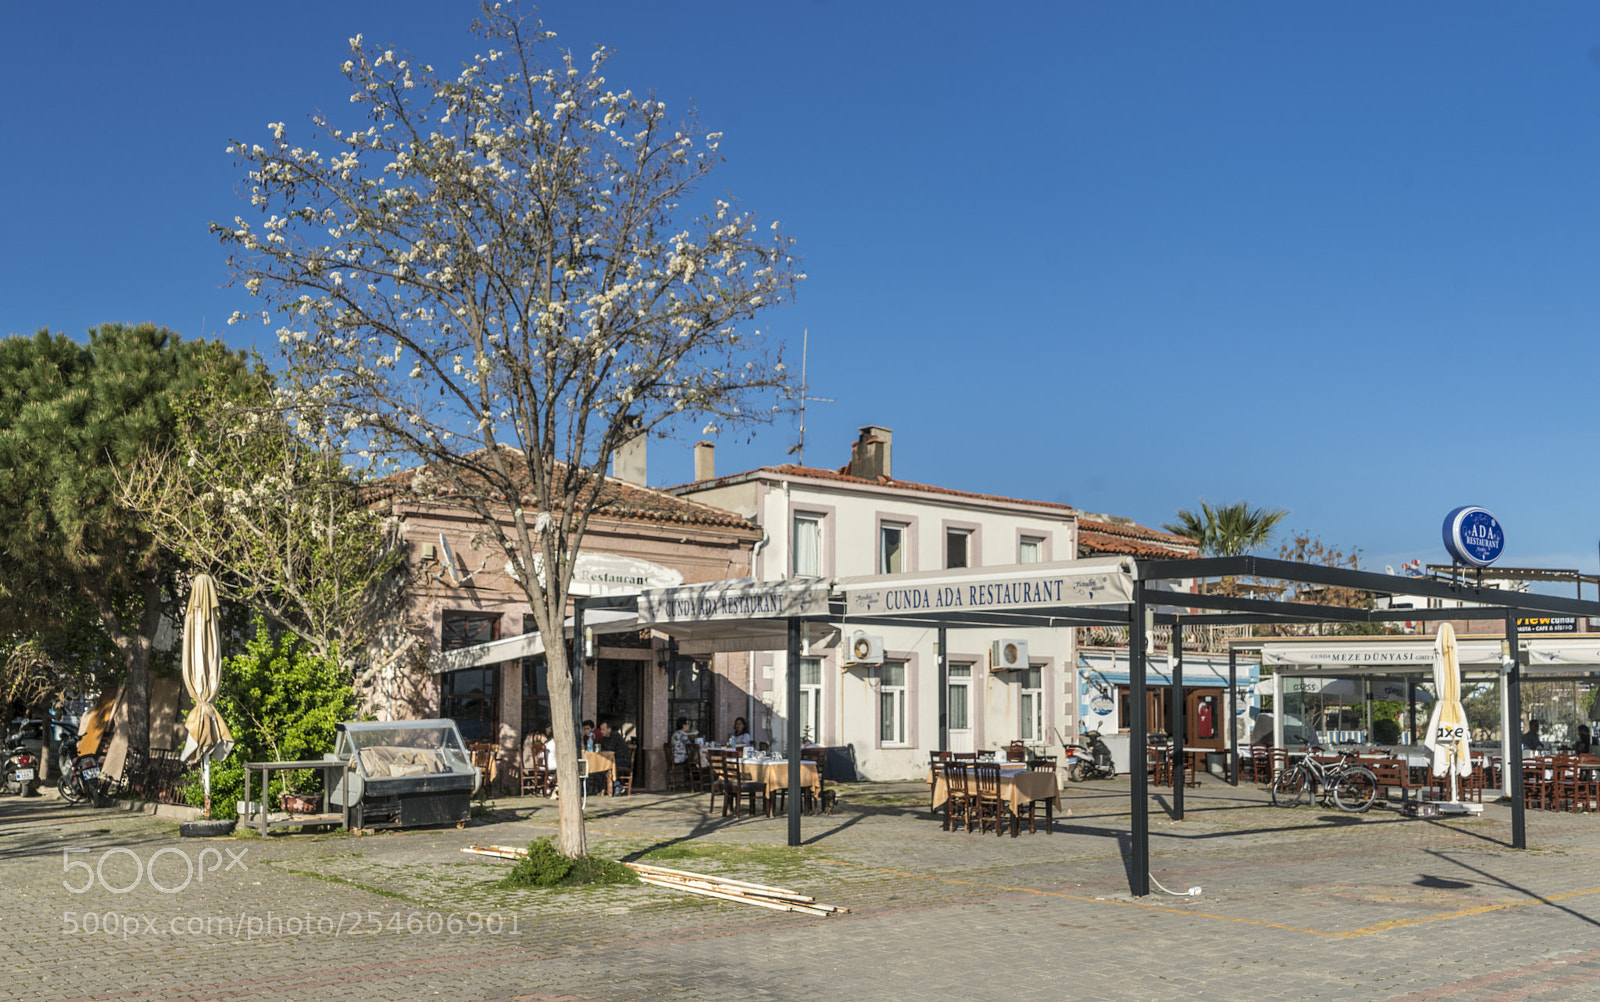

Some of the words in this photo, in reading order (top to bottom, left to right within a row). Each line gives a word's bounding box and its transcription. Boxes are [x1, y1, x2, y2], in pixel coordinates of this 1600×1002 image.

[1471, 524, 1494, 540] ADA
[1466, 536, 1499, 549] RESTAURANT
[886, 590, 931, 610] CUNDA
[936, 587, 963, 607] ADA
[969, 580, 1064, 606] RESTAURANT
[665, 598, 696, 617] CUNDA
[700, 600, 718, 615] ADA
[722, 594, 784, 614] RESTAURANT
[1332, 653, 1361, 661] MEZE
[1364, 652, 1414, 661] DÜNYASI
